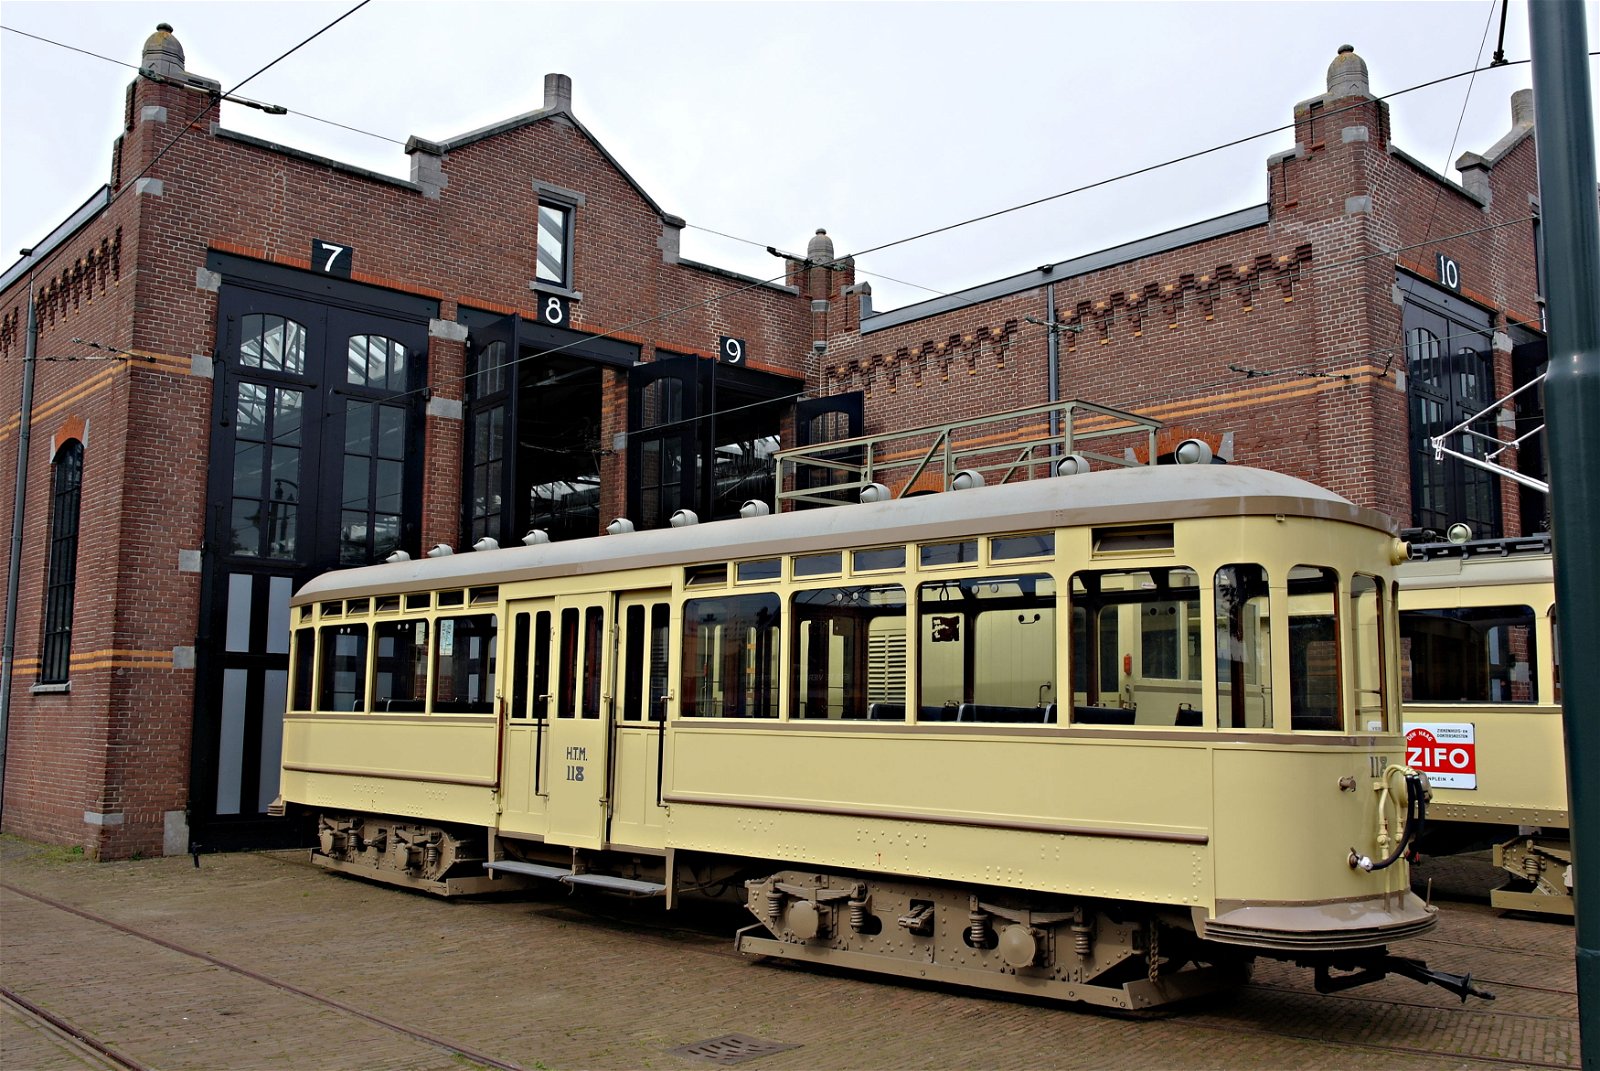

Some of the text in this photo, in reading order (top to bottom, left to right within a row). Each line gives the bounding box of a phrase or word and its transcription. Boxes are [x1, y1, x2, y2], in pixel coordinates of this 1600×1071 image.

[321, 242, 344, 273] 7
[1440, 255, 1458, 289] 10
[545, 296, 563, 324] 8
[726, 338, 742, 363] 9
[1406, 730, 1434, 742] DEN HAAG
[1407, 747, 1470, 769] ZIFO
[566, 765, 584, 781] 118
